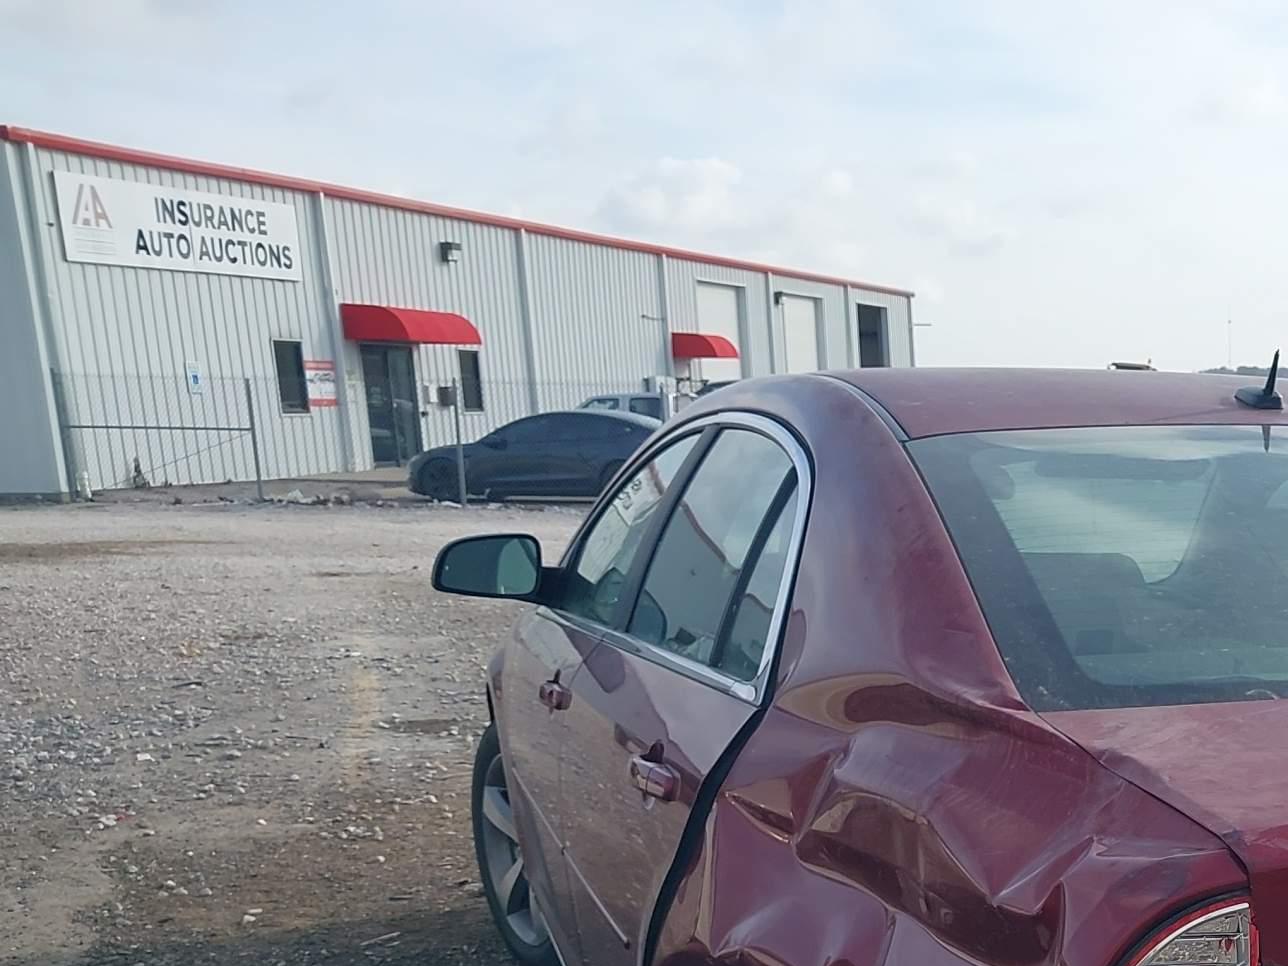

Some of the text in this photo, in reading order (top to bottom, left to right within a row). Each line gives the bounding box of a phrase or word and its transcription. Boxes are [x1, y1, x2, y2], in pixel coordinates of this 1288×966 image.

[154, 197, 268, 236] INSURANCE
[135, 228, 293, 270] AUTO AUCTIONS
